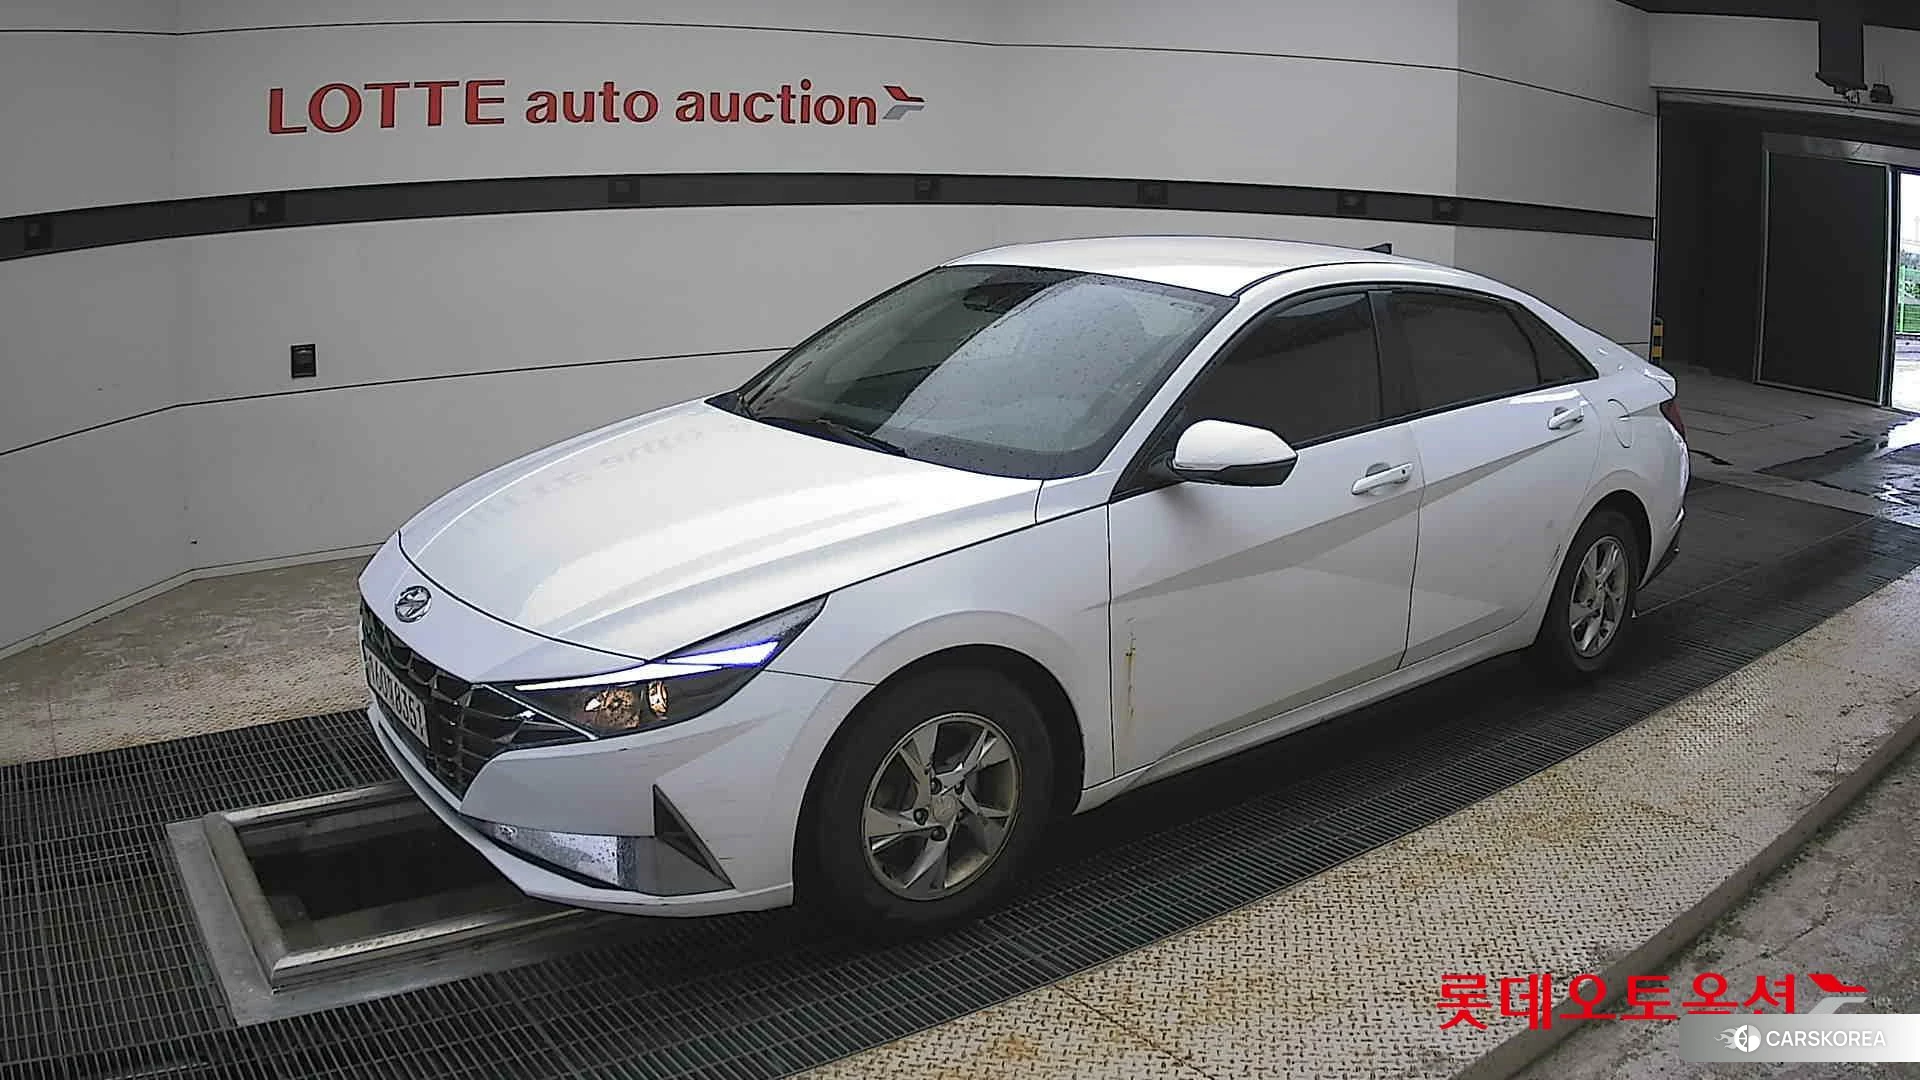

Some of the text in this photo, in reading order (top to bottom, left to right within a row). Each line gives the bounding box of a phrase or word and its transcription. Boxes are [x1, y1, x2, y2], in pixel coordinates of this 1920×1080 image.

[268, 79, 878, 135] LOTTE auto auction
